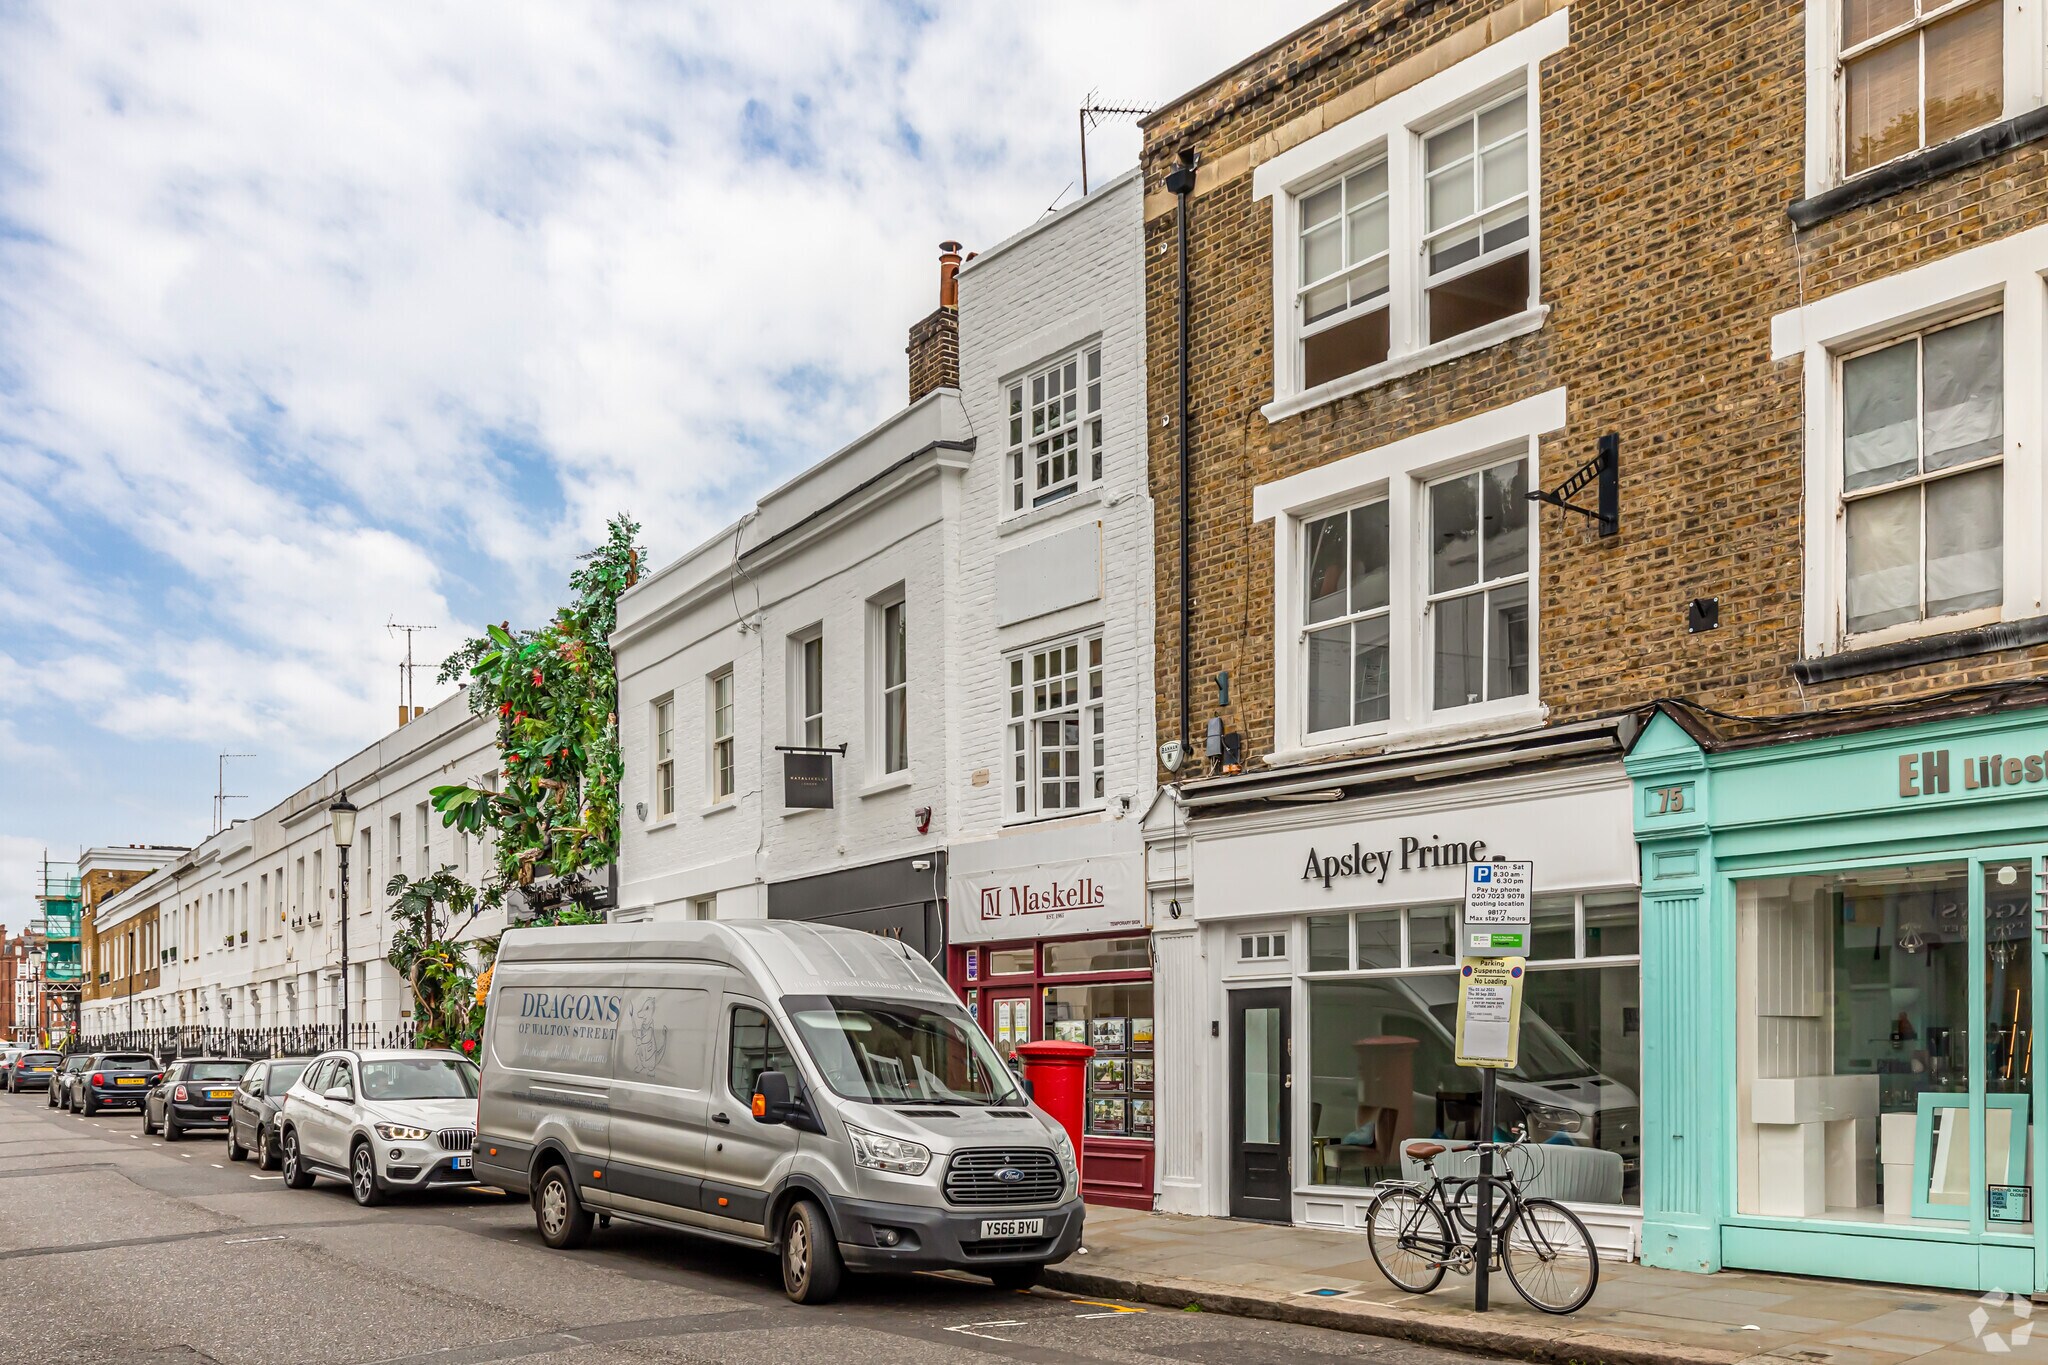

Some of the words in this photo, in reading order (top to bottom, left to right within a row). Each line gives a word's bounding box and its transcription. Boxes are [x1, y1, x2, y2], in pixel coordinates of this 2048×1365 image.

[1899, 750, 1950, 798] EH
[1964, 750, 2048, 790] Lifes
[1657, 786, 1684, 814] 75
[1301, 842, 1392, 888] Apsley
[1399, 834, 1486, 870] Prime
[1009, 878, 1104, 916] Maskells
[823, 980, 859, 988] Painted
[908, 986, 949, 998] Furniture
[520, 992, 621, 1022] DRAGONS
[518, 1023, 531, 1033] OF
[532, 1024, 570, 1037] WALTON
[573, 1026, 617, 1040] STREET
[459, 1159, 471, 1167] LB
[1005, 1172, 1020, 1180] Ford
[987, 1222, 1015, 1235] YS66
[1018, 1221, 1038, 1235] BYU
